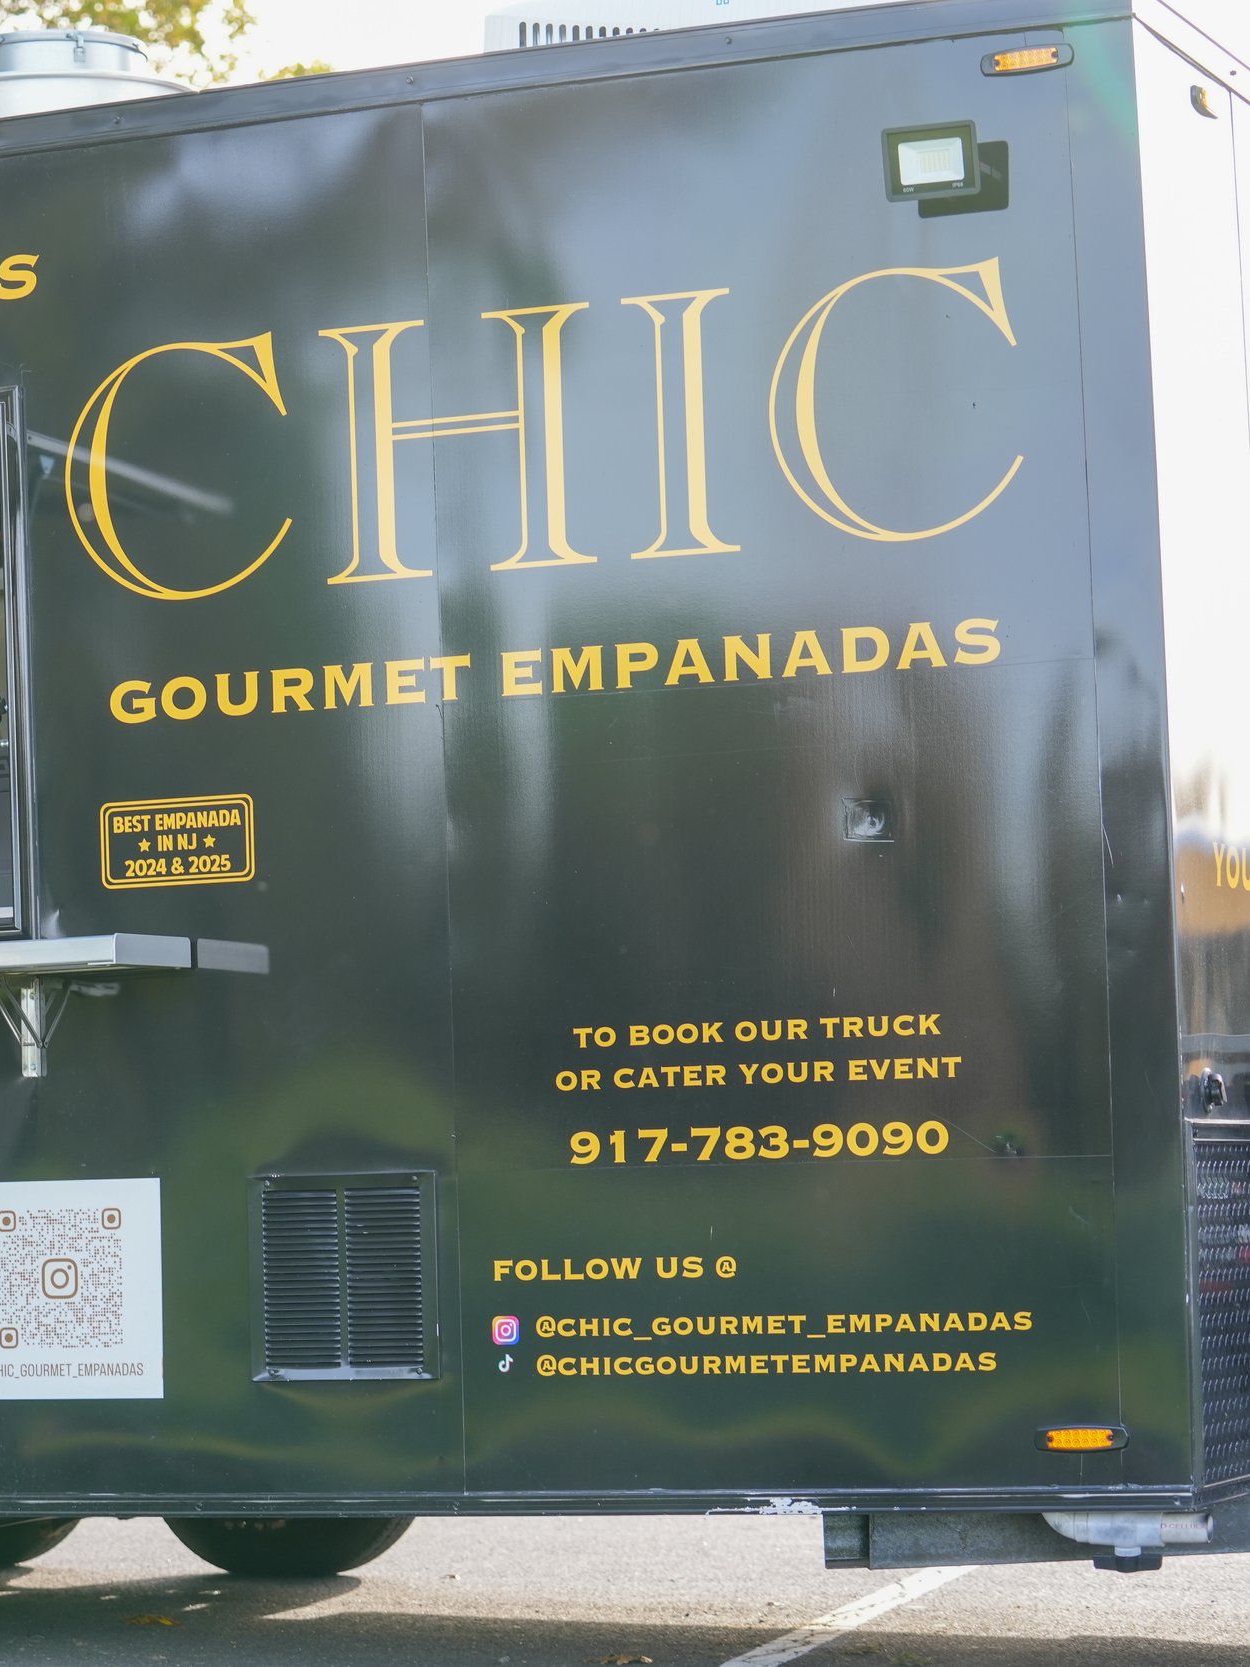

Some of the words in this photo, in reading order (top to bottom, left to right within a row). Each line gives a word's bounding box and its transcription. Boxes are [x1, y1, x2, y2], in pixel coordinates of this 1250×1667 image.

[65, 257, 1024, 601] CHIC
[110, 655, 470, 723] GOURMET
[503, 620, 1001, 695] EMPANADAS
[113, 815, 151, 834] BEST
[155, 808, 241, 831] EMPANADA
[158, 835, 173, 851] IN
[178, 833, 196, 850] NJ
[125, 858, 167, 877] 2024
[171, 857, 184, 874] &
[188, 854, 232, 873] 2025
[574, 1027, 616, 1047] TO
[630, 1023, 723, 1045] BOOK
[735, 1019, 807, 1041] OUR
[820, 1014, 940, 1038] TRUCK
[556, 1070, 600, 1091] OR
[614, 1065, 726, 1088] CATER
[740, 1061, 834, 1084] YOUR
[849, 1057, 961, 1080] EVENT
[571, 1121, 948, 1164] 917-783-9090
[494, 1258, 641, 1281] FOLLOW
[657, 1257, 703, 1278] US
[716, 1256, 736, 1278] @
[536, 1312, 1032, 1340] @CHIC_GOURMET_EMPANADAS
[537, 1352, 996, 1376] @CHICGOURMETEMPANADAS
